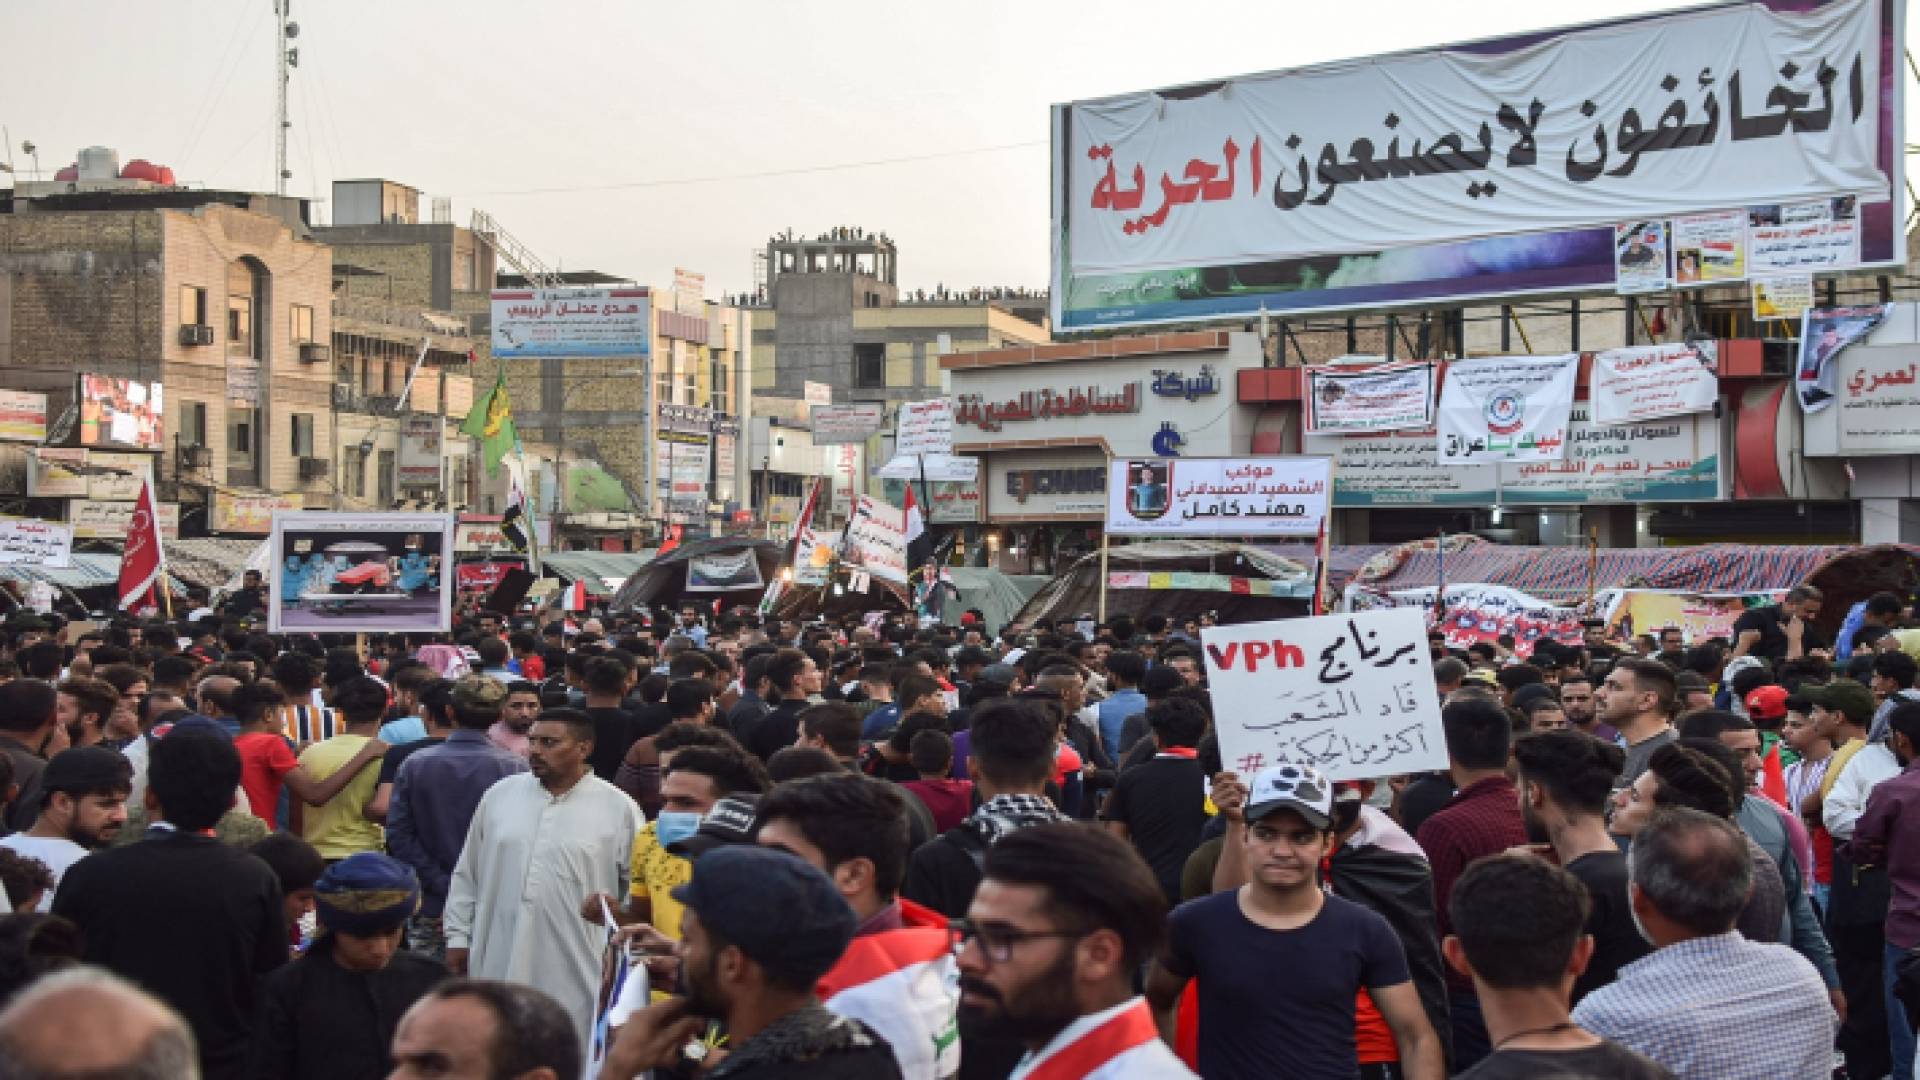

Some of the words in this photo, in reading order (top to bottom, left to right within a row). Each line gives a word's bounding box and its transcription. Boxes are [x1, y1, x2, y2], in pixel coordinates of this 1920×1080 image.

[1565, 51, 1863, 183] الخائفون
[1498, 98, 1547, 169] لا
[1274, 112, 1496, 210] يصنعون
[1090, 134, 1262, 235] الحرية
[1151, 364, 1219, 402] شركة
[1846, 362, 1918, 397] لعمري
[1444, 434, 1485, 457] عراق
[1518, 429, 1562, 456] لبيك
[1225, 464, 1275, 481] موكب
[1518, 456, 1586, 478] الشامي
[1645, 458, 1691, 473] سحر
[1176, 481, 1256, 502] الصيدلاني
[1261, 481, 1324, 501] الشهيد
[1182, 499, 1240, 519] كامل
[1245, 501, 1305, 517] مهند
